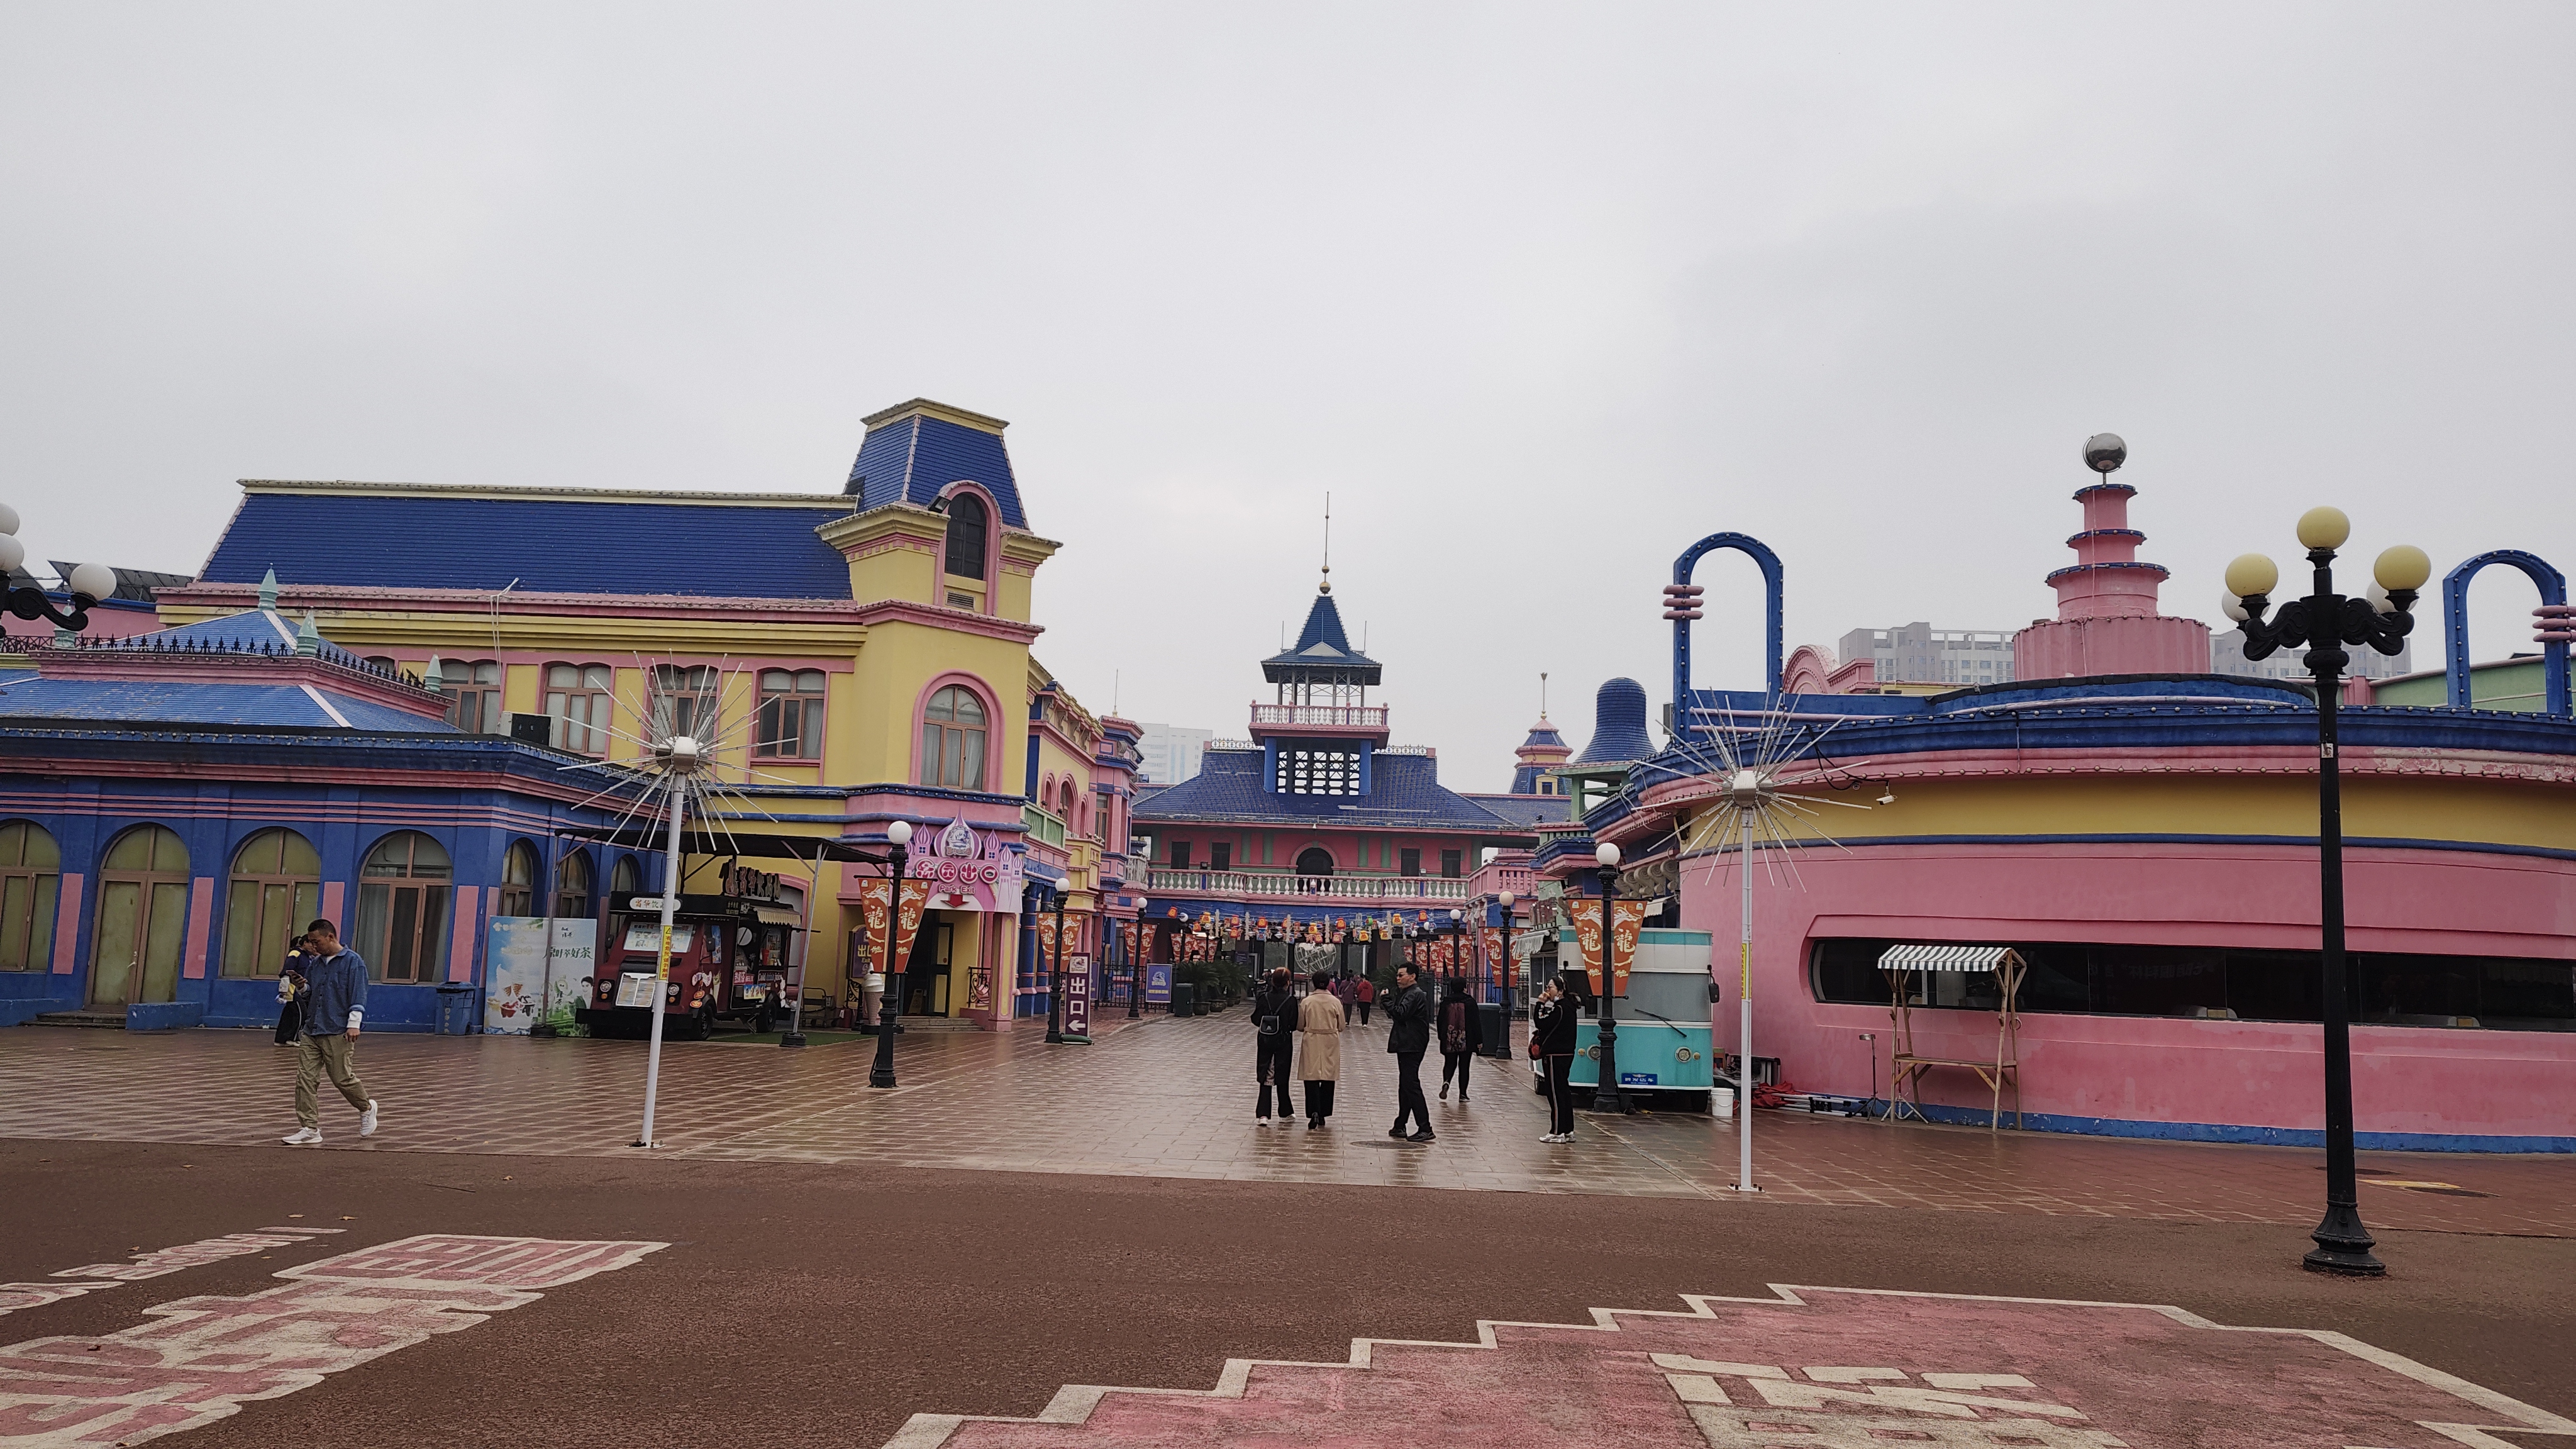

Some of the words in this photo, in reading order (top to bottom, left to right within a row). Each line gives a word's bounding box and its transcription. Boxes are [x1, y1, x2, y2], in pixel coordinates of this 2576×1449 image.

[938, 884, 957, 893] Park
[959, 886, 976, 894] Exit
[864, 904, 886, 930] 龍
[898, 906, 918, 930] 龍
[1578, 926, 1602, 952] 龍
[1614, 928, 1636, 953] 龍
[1069, 977, 1086, 1016] 出口
[48, 1233, 316, 1280] HOPE
